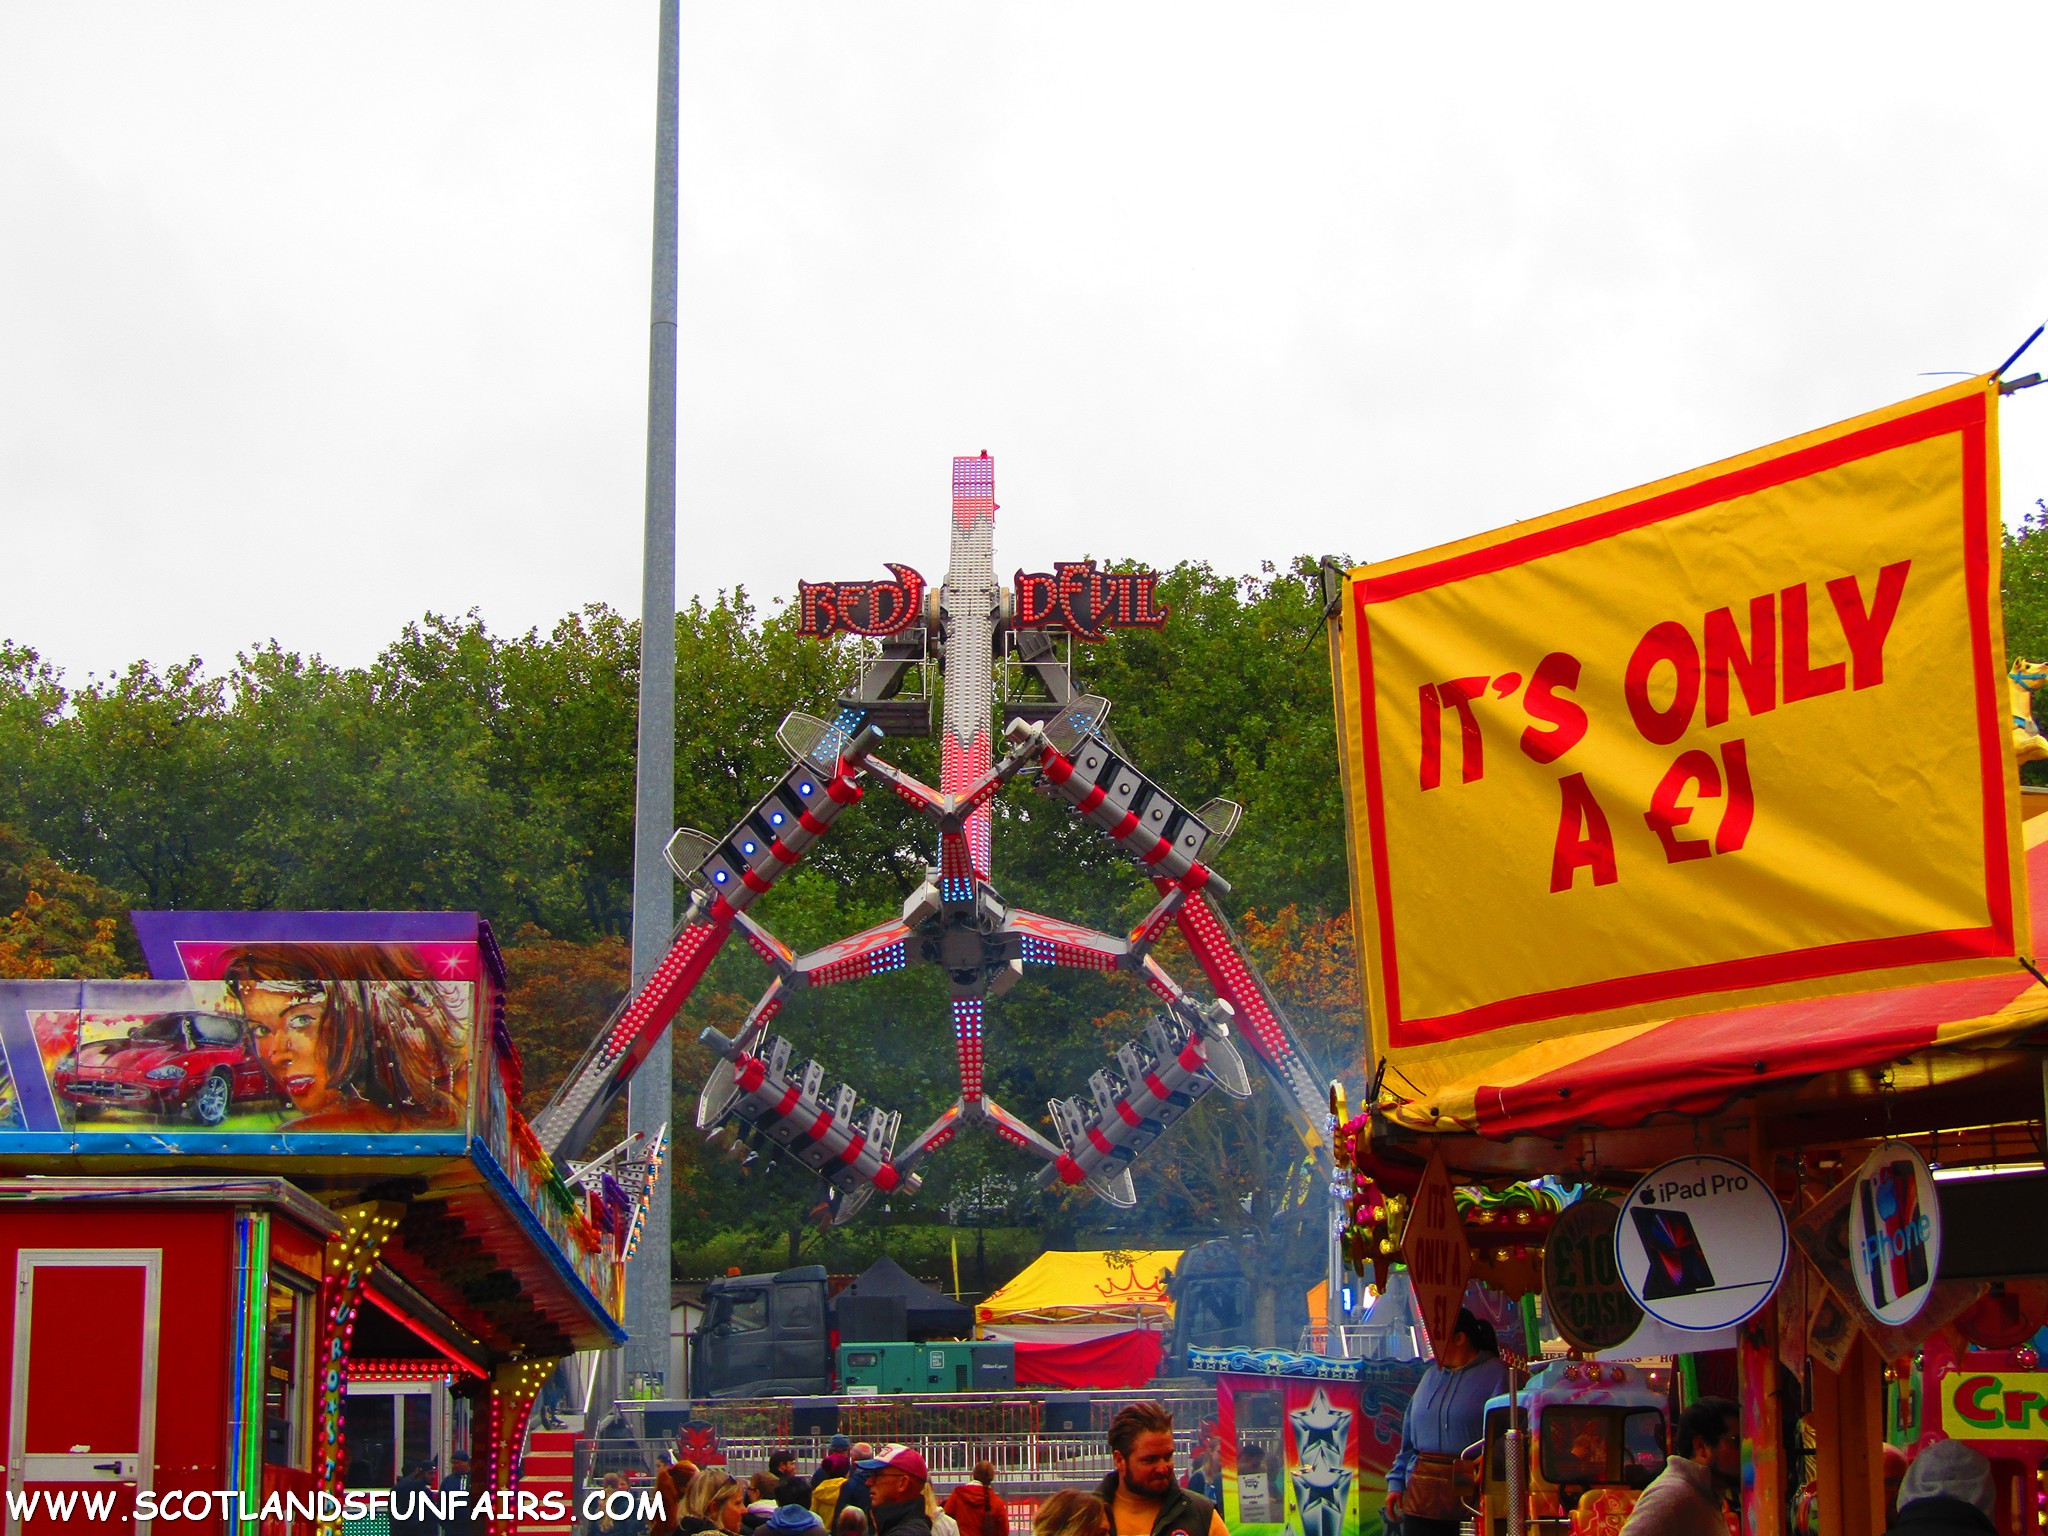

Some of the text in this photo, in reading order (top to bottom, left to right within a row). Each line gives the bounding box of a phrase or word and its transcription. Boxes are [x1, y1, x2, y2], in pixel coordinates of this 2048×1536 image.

[1013, 561, 1169, 641] DEVIL
[1418, 559, 1911, 791] IT'S ONLY
[1549, 738, 1754, 893] A £1
[1659, 1175, 1748, 1202] iPad Pro
[1415, 1237, 1461, 1286] ONLY A
[1553, 1234, 1616, 1287] £10
[1861, 1214, 1931, 1275] iPhone
[327, 1268, 359, 1392] EURO
[1570, 1291, 1632, 1328] CASH
